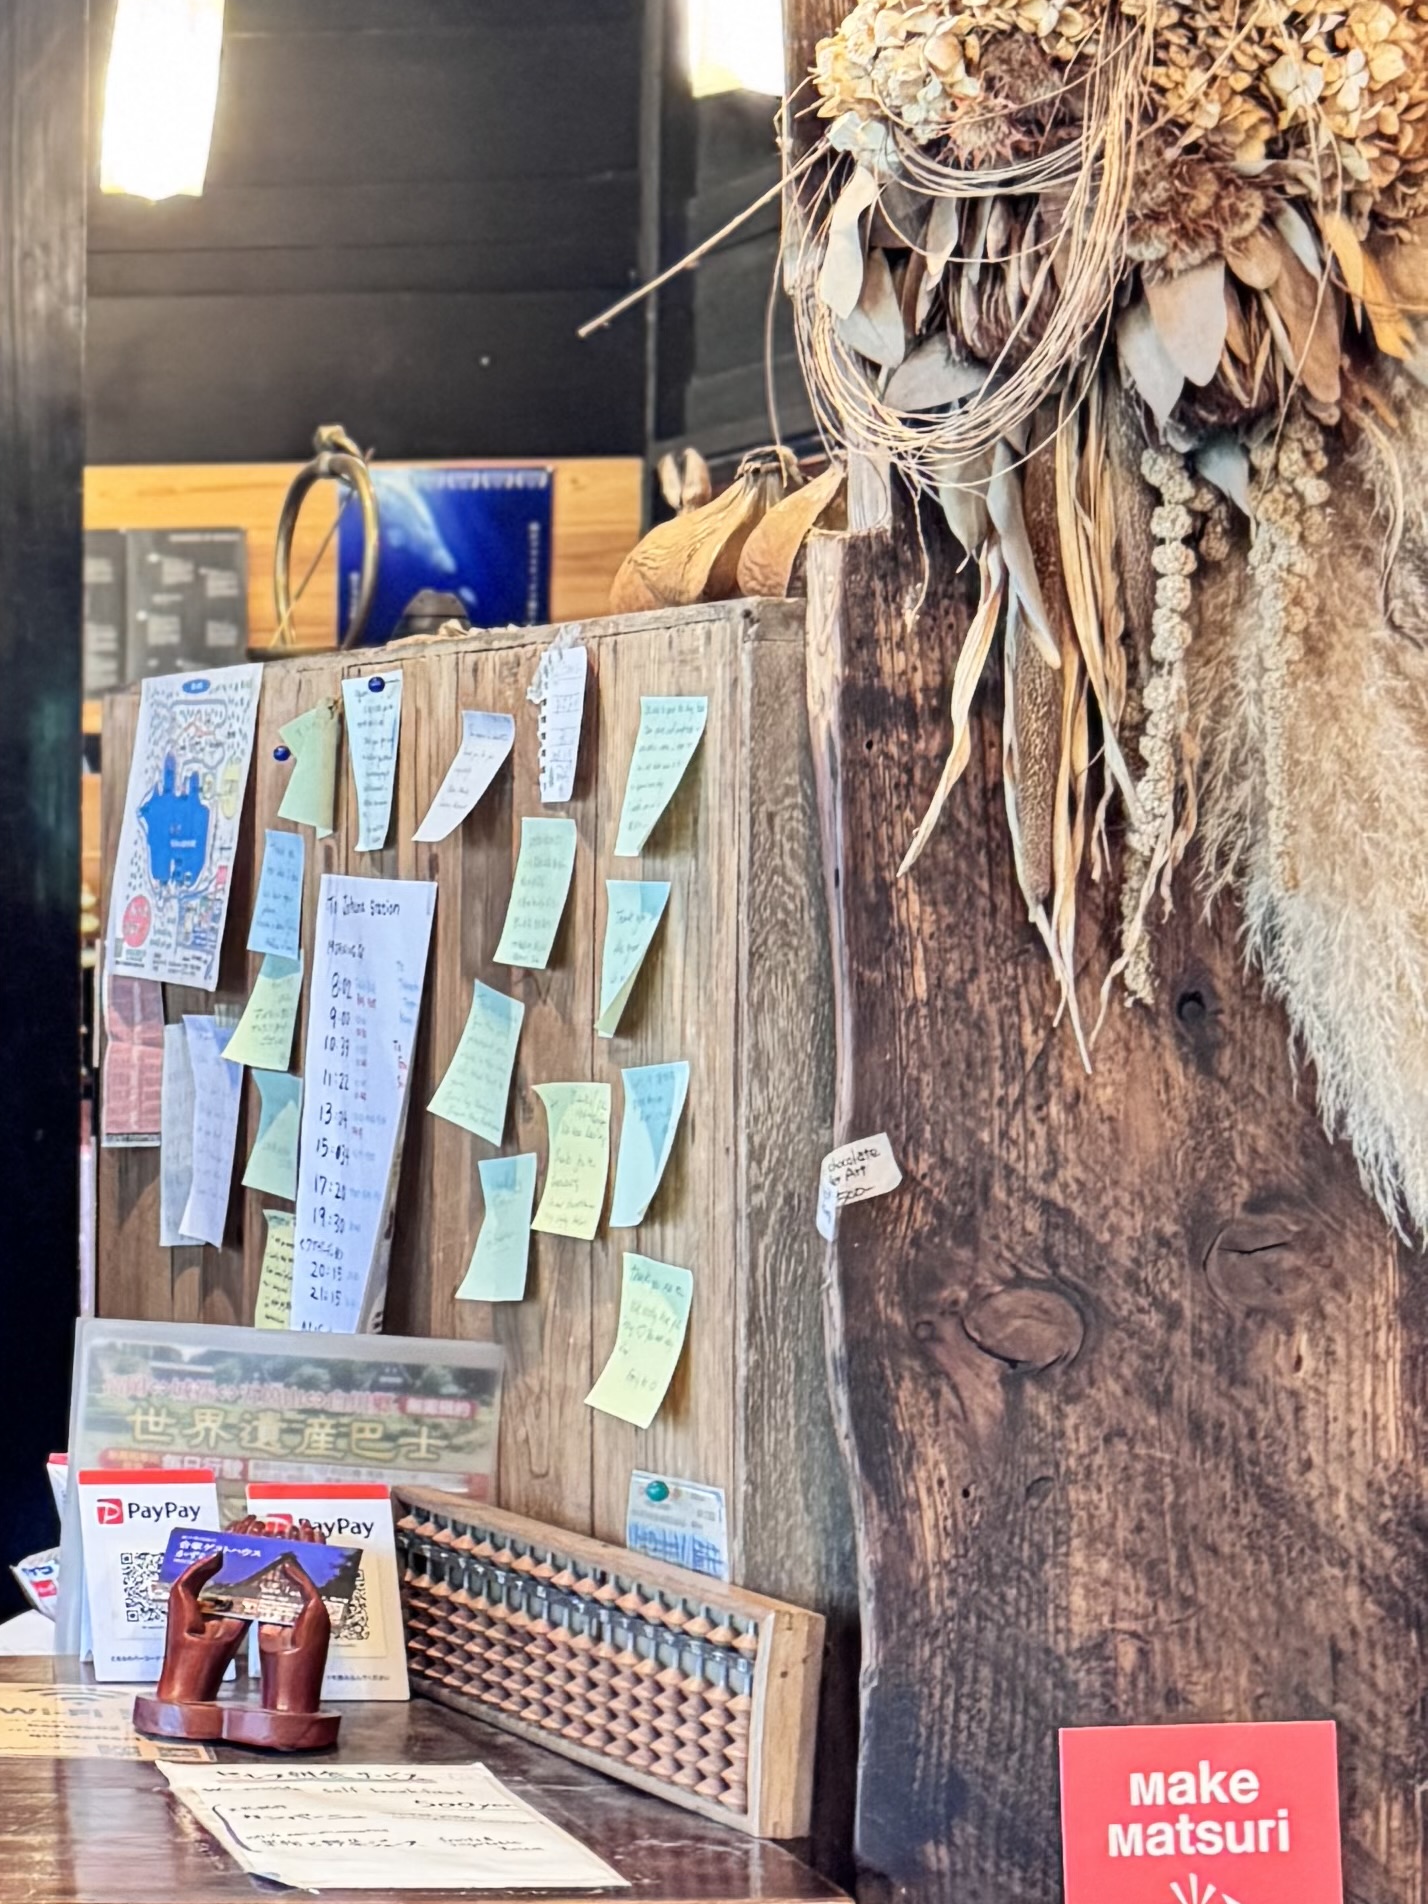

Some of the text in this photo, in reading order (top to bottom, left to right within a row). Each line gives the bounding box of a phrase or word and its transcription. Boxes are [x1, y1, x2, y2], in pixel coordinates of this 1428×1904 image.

[128, 1501, 201, 1522] PayPay
[298, 1517, 374, 1539] PayPay
[1130, 1760, 1259, 1807] Make
[1108, 1809, 1290, 1858] Matsuri
